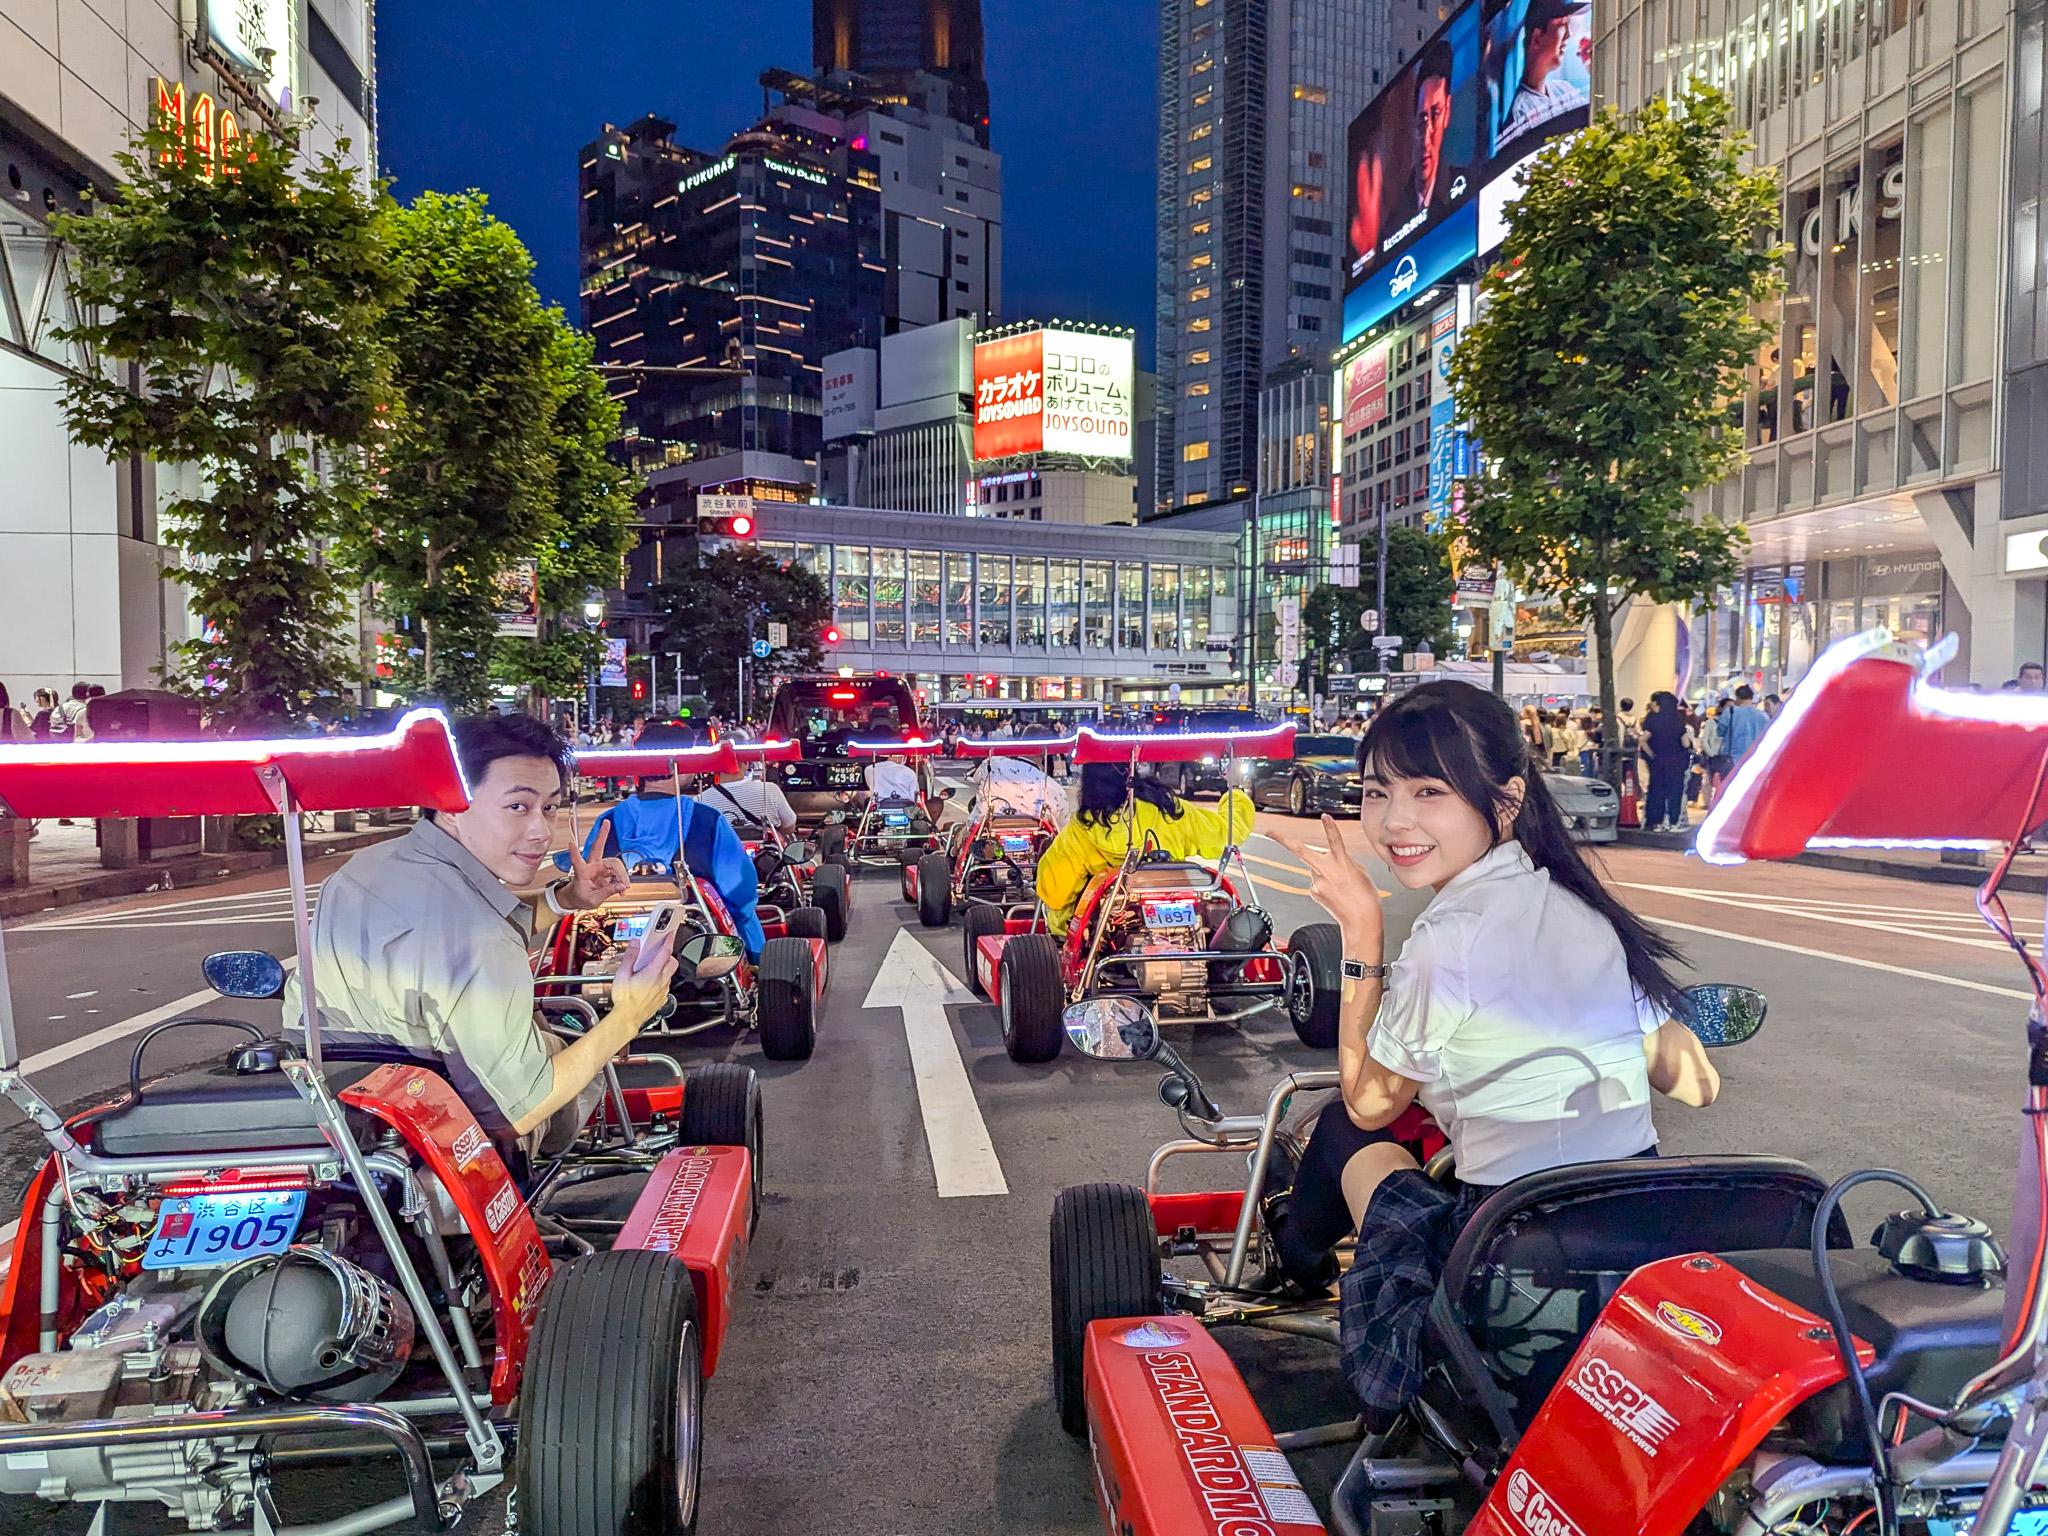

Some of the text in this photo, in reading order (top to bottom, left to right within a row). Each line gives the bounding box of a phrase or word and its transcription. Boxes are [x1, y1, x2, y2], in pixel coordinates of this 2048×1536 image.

[687, 157, 735, 190] FUKURAS
[763, 158, 828, 186] TOKYU PLAZA
[1047, 352, 1110, 377] ココロの
[977, 369, 1041, 406] カラオケ
[1046, 374, 1128, 400] ボリューム、
[977, 396, 1042, 424] JOYSOUND
[1046, 395, 1129, 417] あげていこう。
[1046, 413, 1129, 437] JOYSOUND
[702, 498, 748, 509] 渋谷駅前
[834, 772, 861, 783] 69-87
[1157, 910, 1192, 924] 1897
[196, 1197, 266, 1219] 渋谷区
[154, 1212, 296, 1258] よ 1905
[1566, 1378, 1658, 1458] STANDARD SPORT POWER
